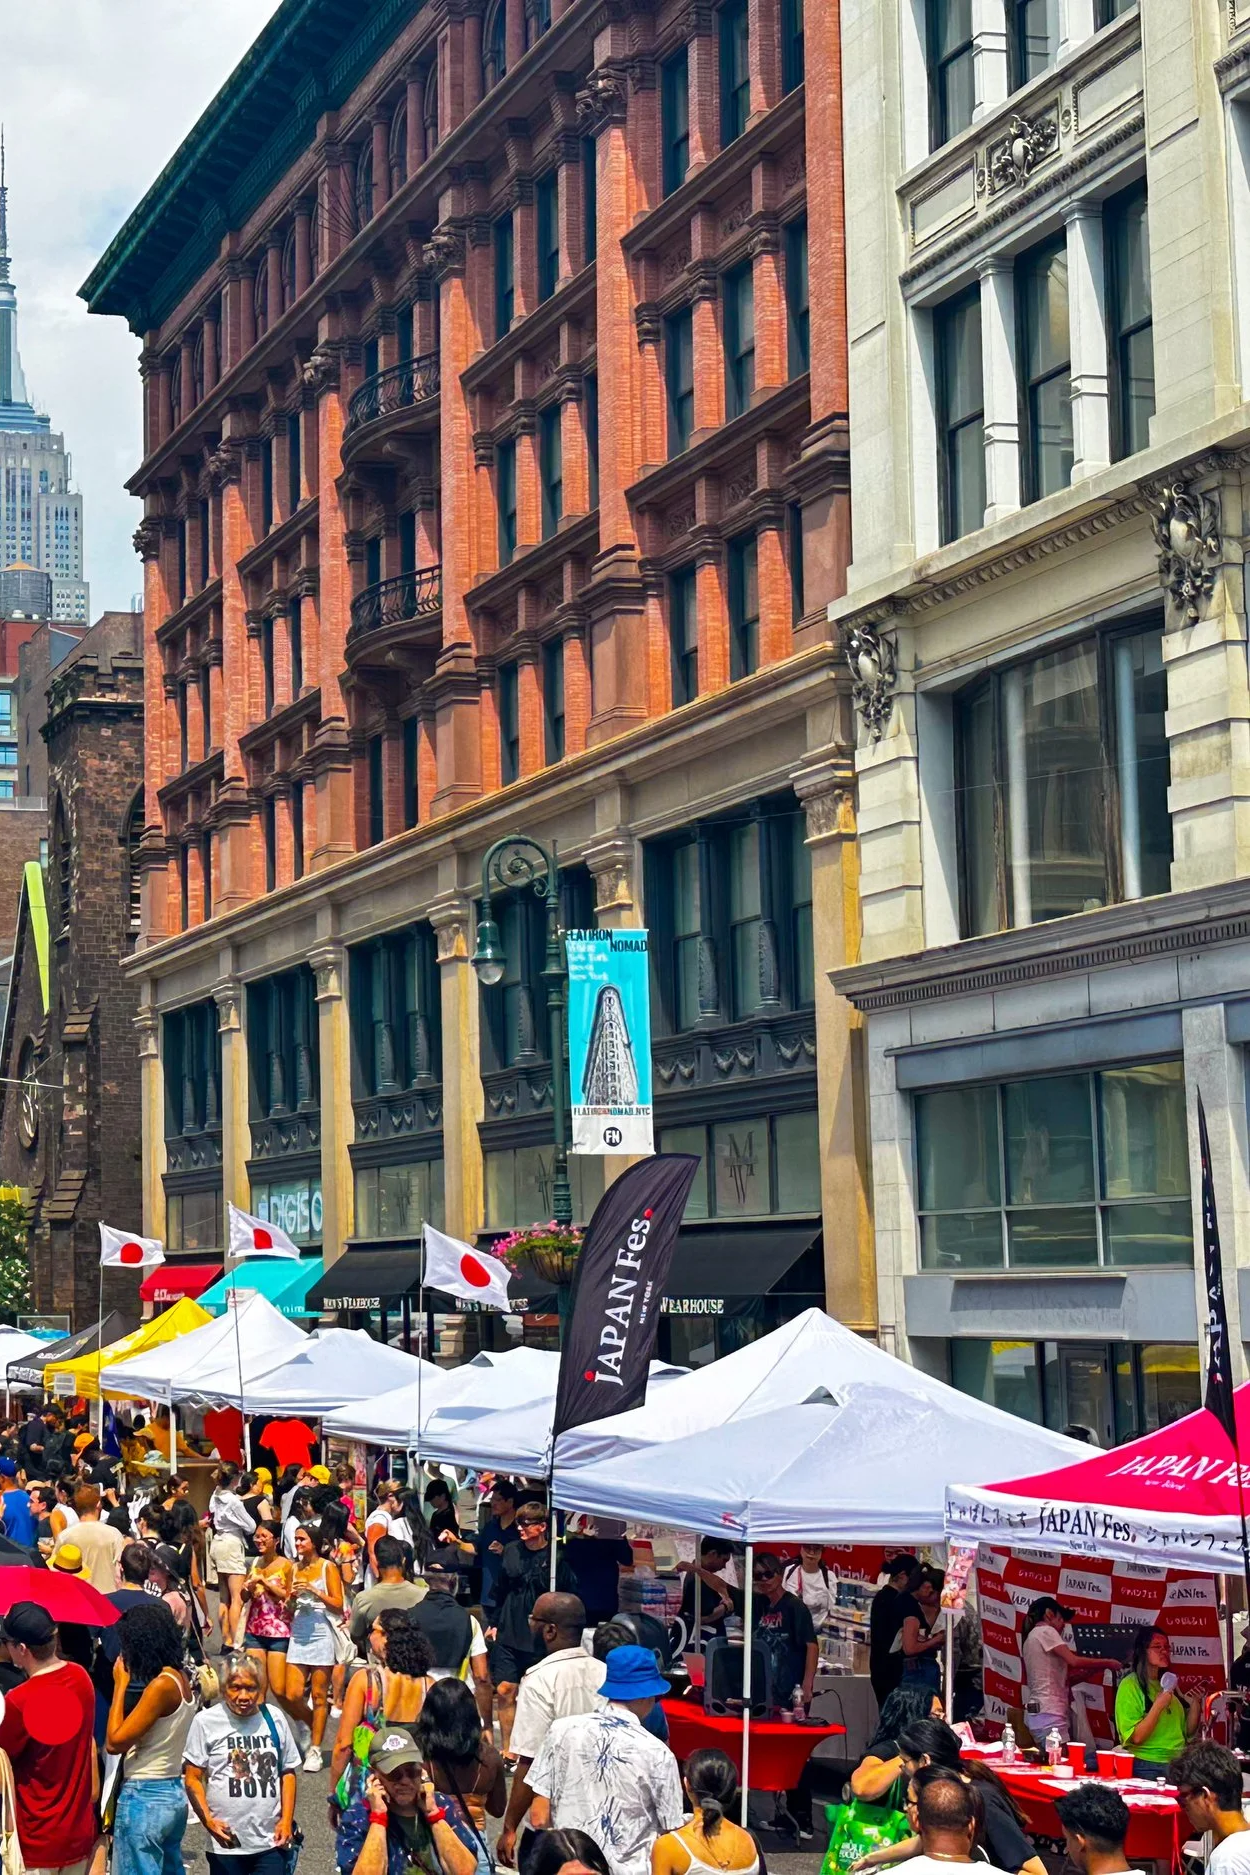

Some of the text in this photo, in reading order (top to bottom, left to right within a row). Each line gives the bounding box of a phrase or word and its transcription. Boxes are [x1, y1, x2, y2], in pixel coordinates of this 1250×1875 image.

[611, 940, 647, 952] NOMAD
[592, 1274, 639, 1387] JAPAN
[1039, 1506, 1098, 1537] JAPAN
[1065, 1575, 1086, 1590] JAPAN
[228, 1776, 277, 1798] BOYS
